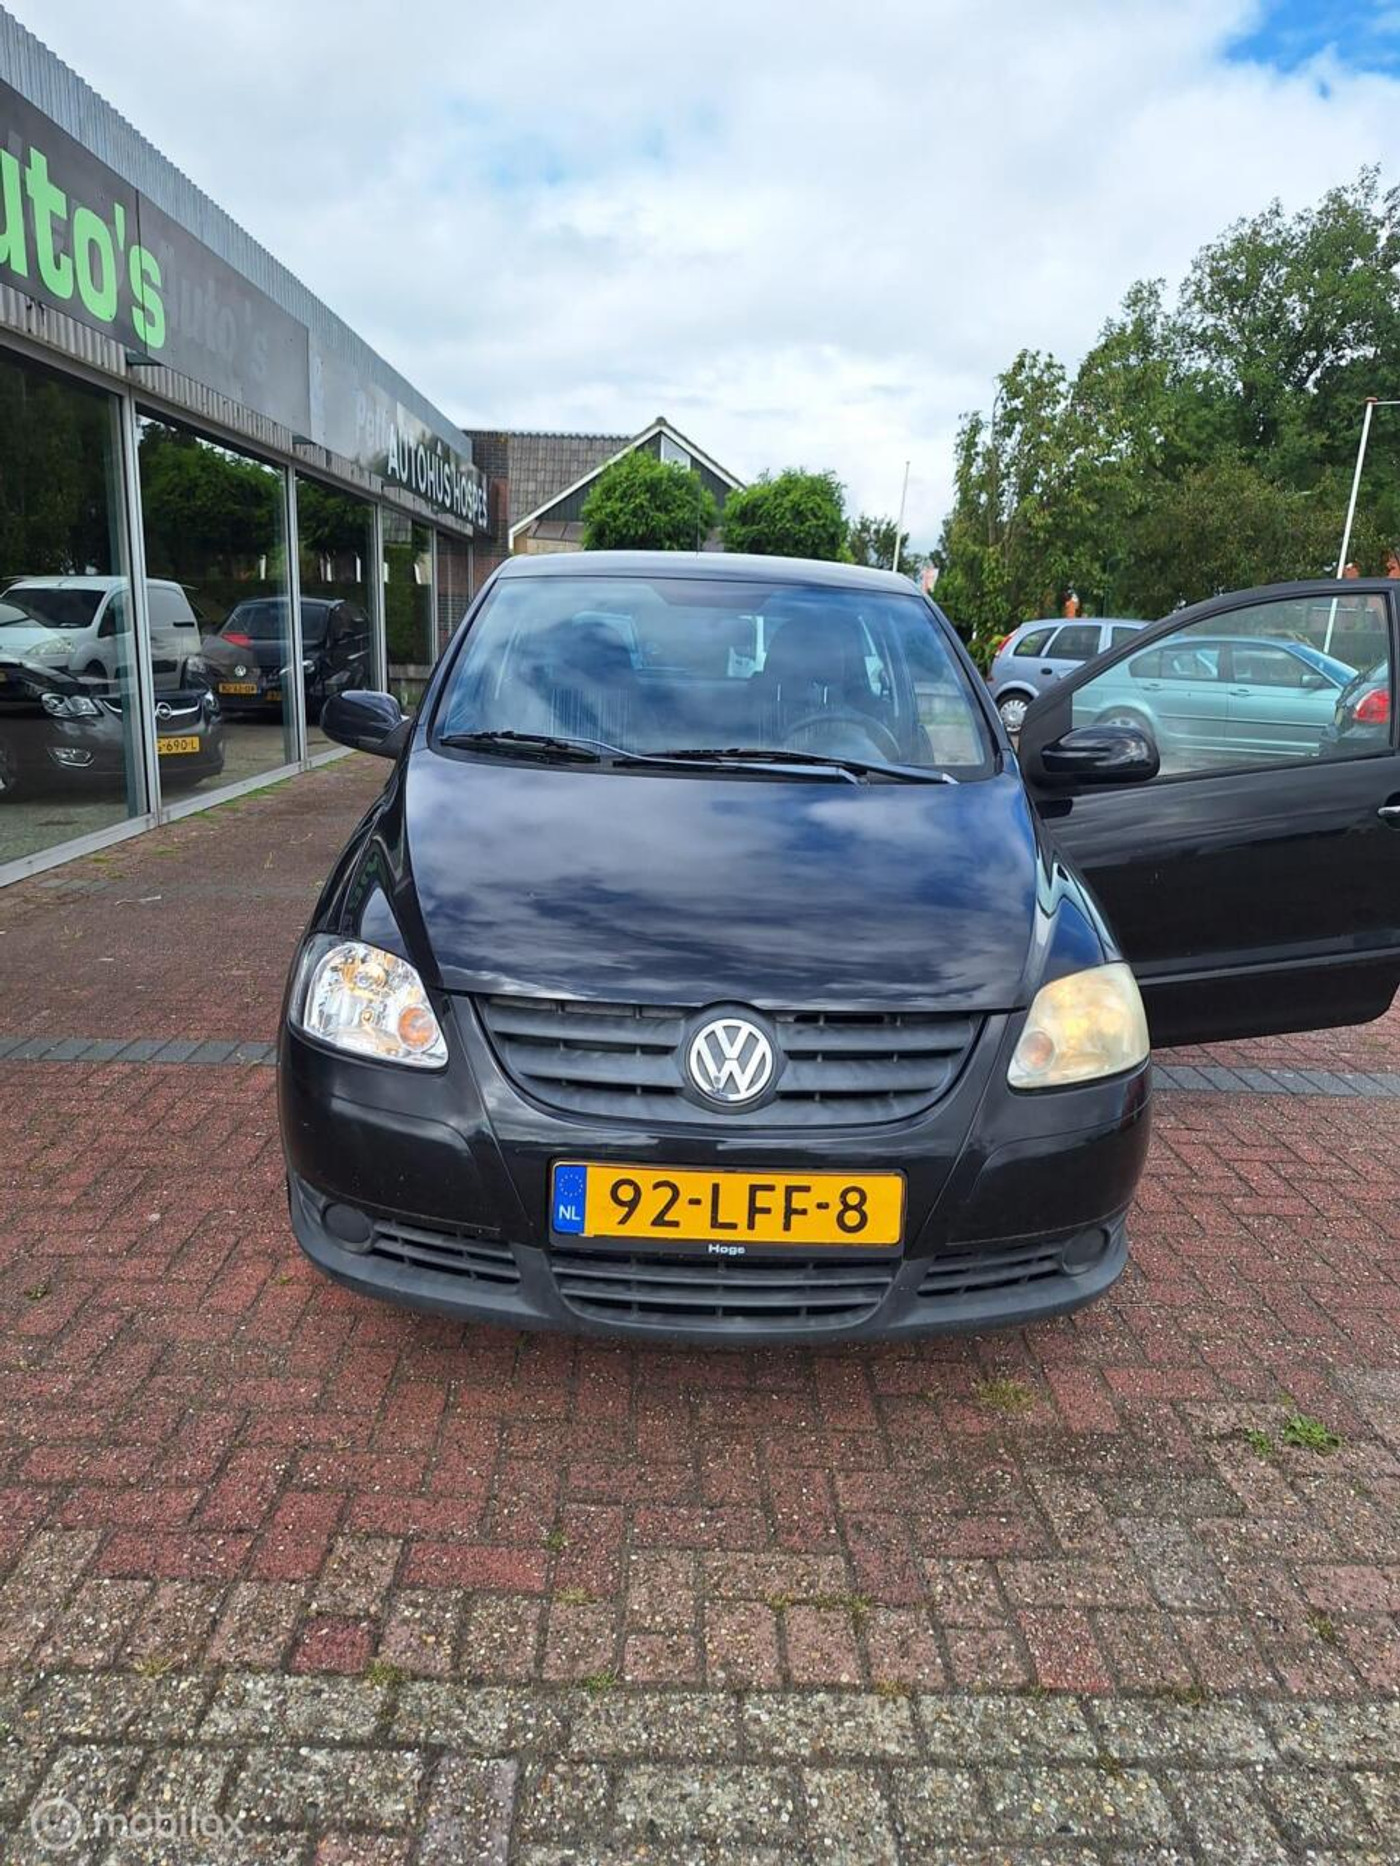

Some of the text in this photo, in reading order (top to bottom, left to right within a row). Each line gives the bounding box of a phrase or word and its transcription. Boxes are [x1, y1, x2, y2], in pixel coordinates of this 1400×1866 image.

[690, 1018, 773, 1102] VW
[558, 1205, 581, 1221] NL
[609, 1178, 869, 1234] 92-LFF-8
[708, 1244, 745, 1256] Hoge
